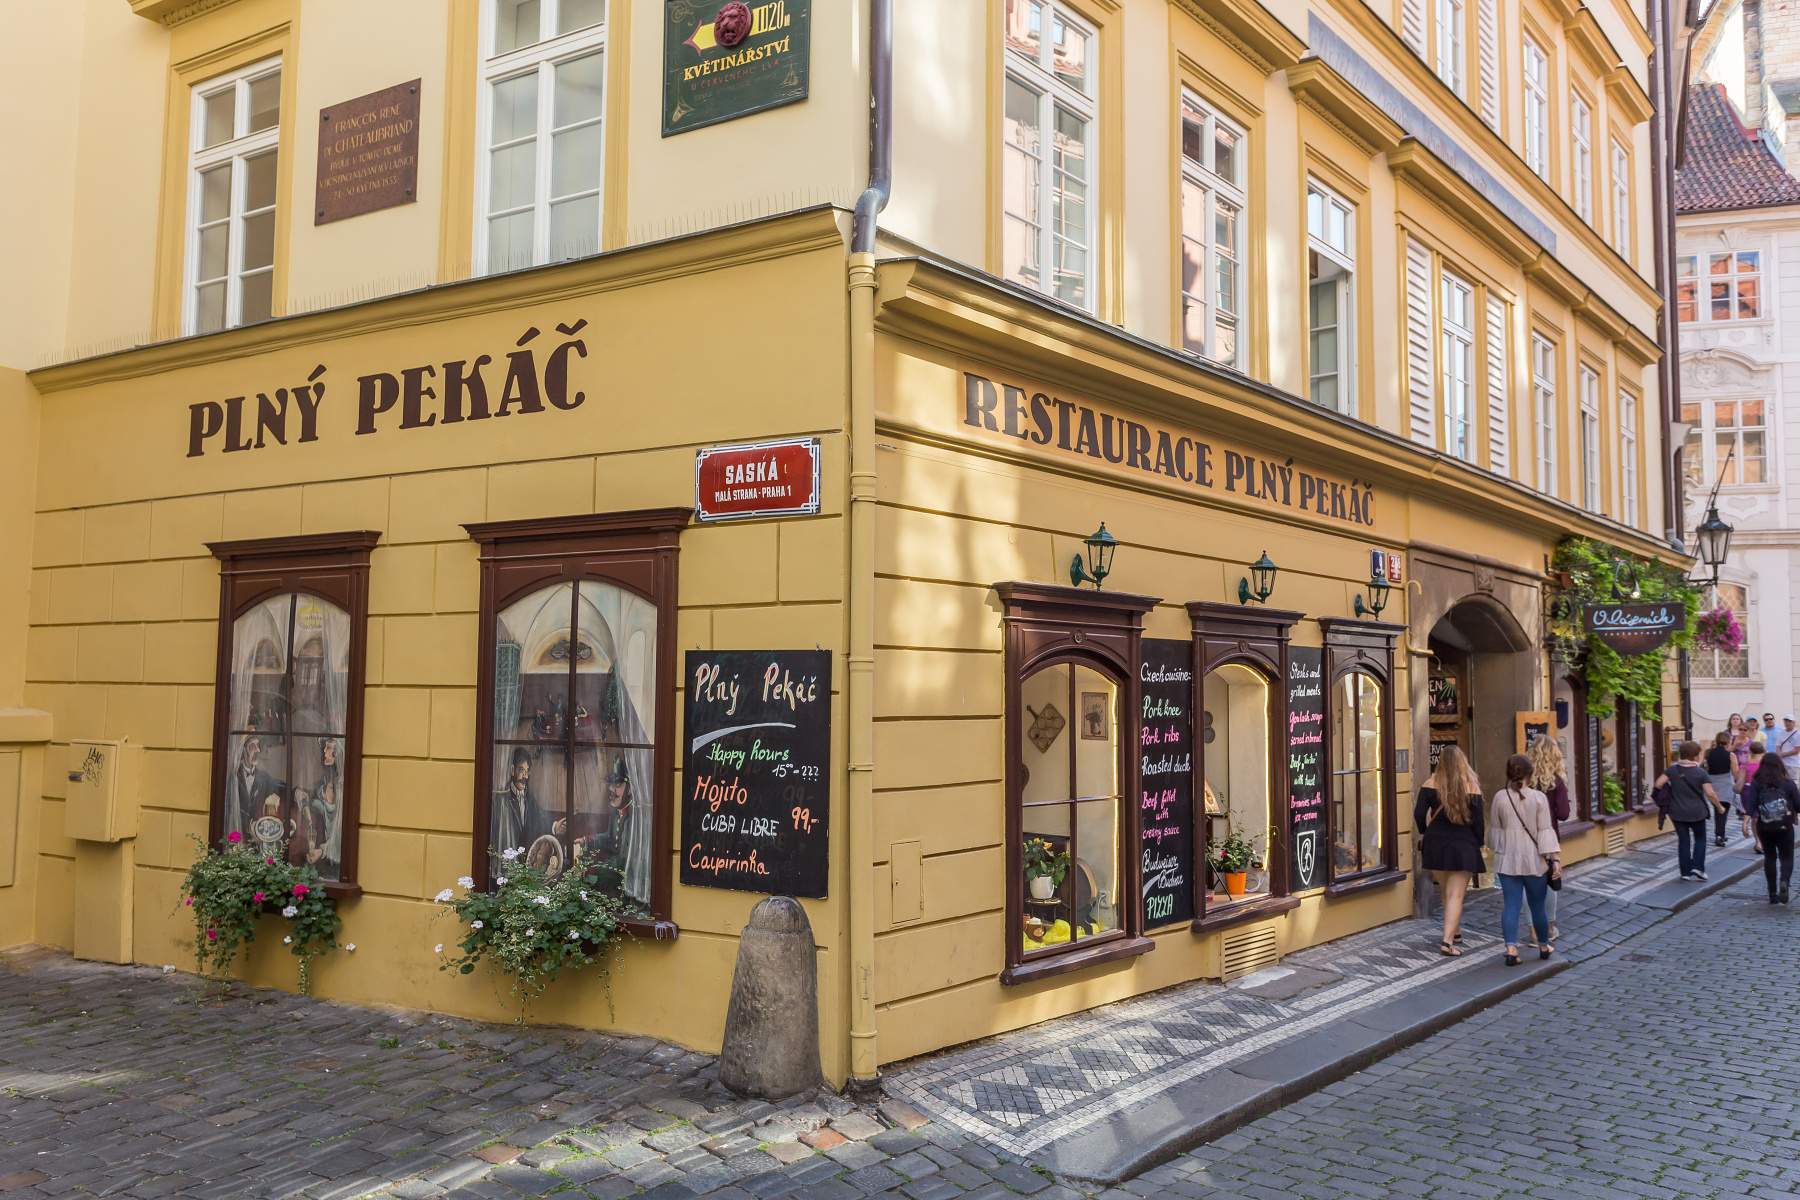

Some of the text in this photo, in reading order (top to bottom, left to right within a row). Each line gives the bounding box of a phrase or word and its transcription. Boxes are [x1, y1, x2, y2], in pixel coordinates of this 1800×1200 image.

[683, 35, 790, 81] KVĚTINÁŘSTVÍ
[186, 318, 588, 458] PLNÝ PEKÁČ
[963, 371, 1376, 526] RESTAURACE PLNÝ PEKÁČ
[725, 457, 778, 485] SASKÁ
[715, 487, 731, 502] MALÁ
[733, 487, 758, 501] STRANA
[762, 485, 786, 498] PRAHA
[787, 485, 792, 496] 1
[1140, 662, 1165, 683] Czech
[695, 662, 817, 716] Plný Pekáč
[1143, 695, 1182, 719] Pork knee
[1141, 725, 1180, 746] Pork ribs
[706, 739, 790, 770] Happy hours
[1142, 753, 1191, 776] Roasted duck
[693, 775, 748, 812] Mojito
[1142, 791, 1158, 810] Beef
[701, 813, 780, 837] CUBA LIBRE
[689, 842, 770, 876] Caipirinha
[1147, 893, 1174, 920] PIZZA
